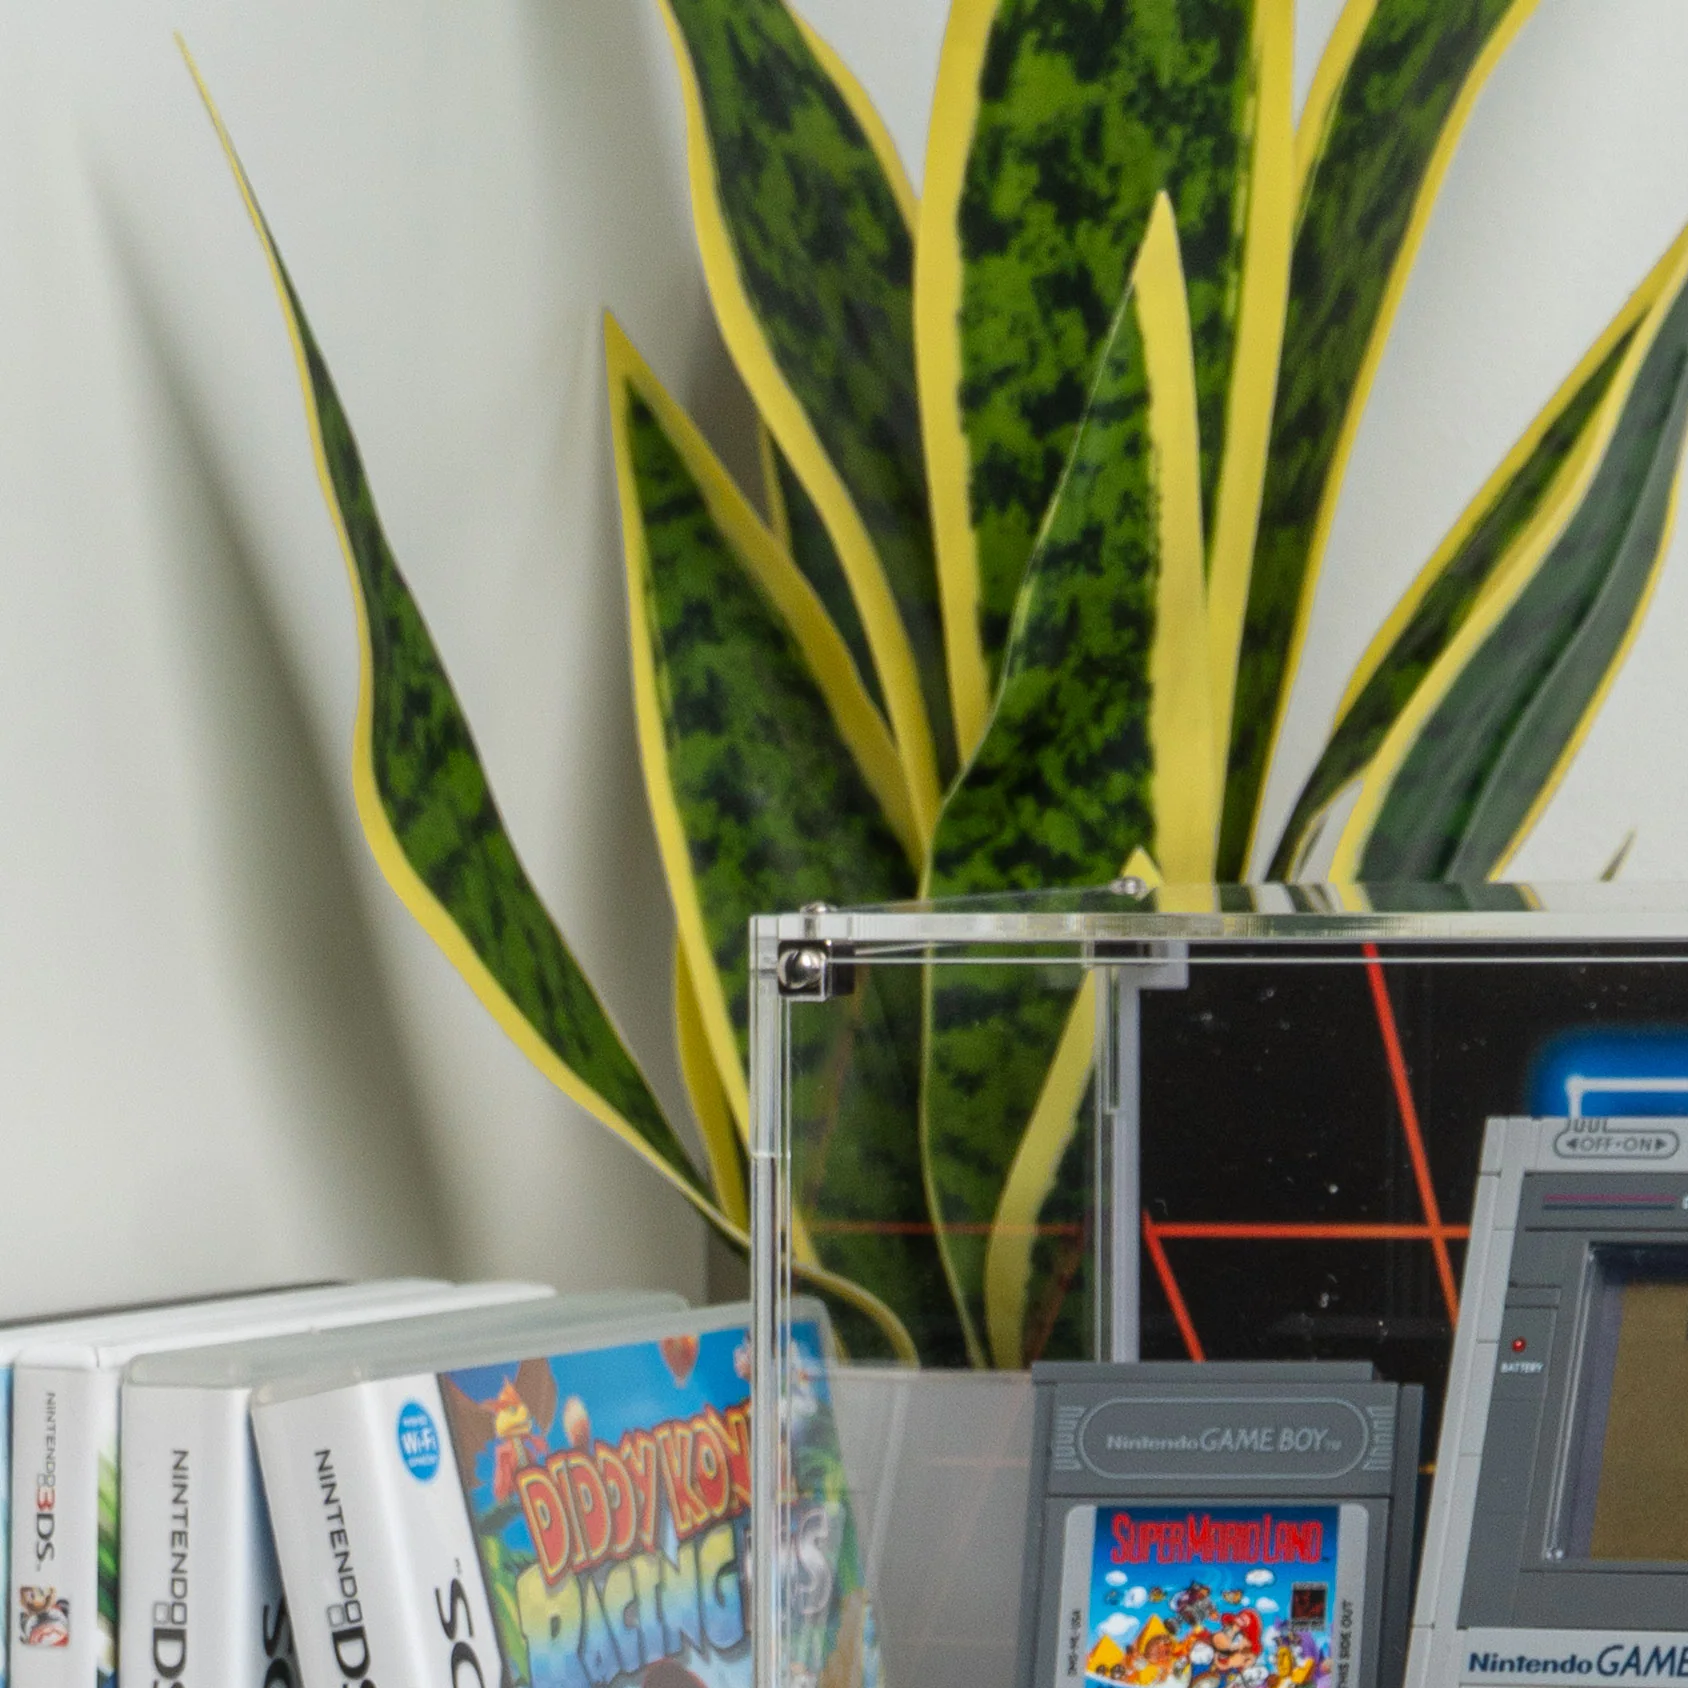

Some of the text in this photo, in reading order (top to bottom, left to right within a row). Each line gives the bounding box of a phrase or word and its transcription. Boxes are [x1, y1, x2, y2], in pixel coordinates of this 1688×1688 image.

[1500, 1361, 1544, 1374] BATTERY
[1106, 1427, 1329, 1452] Nintendo GAME BOY
[517, 1399, 790, 1587] DIDDY KON
[36, 1486, 56, 1562] 3DS
[1110, 1511, 1324, 1564] SUPER MARIO LAND
[1341, 1599, 1354, 1629] OUT
[1339, 1631, 1352, 1659] SIDE
[1467, 1651, 1594, 1675] Nintendo
